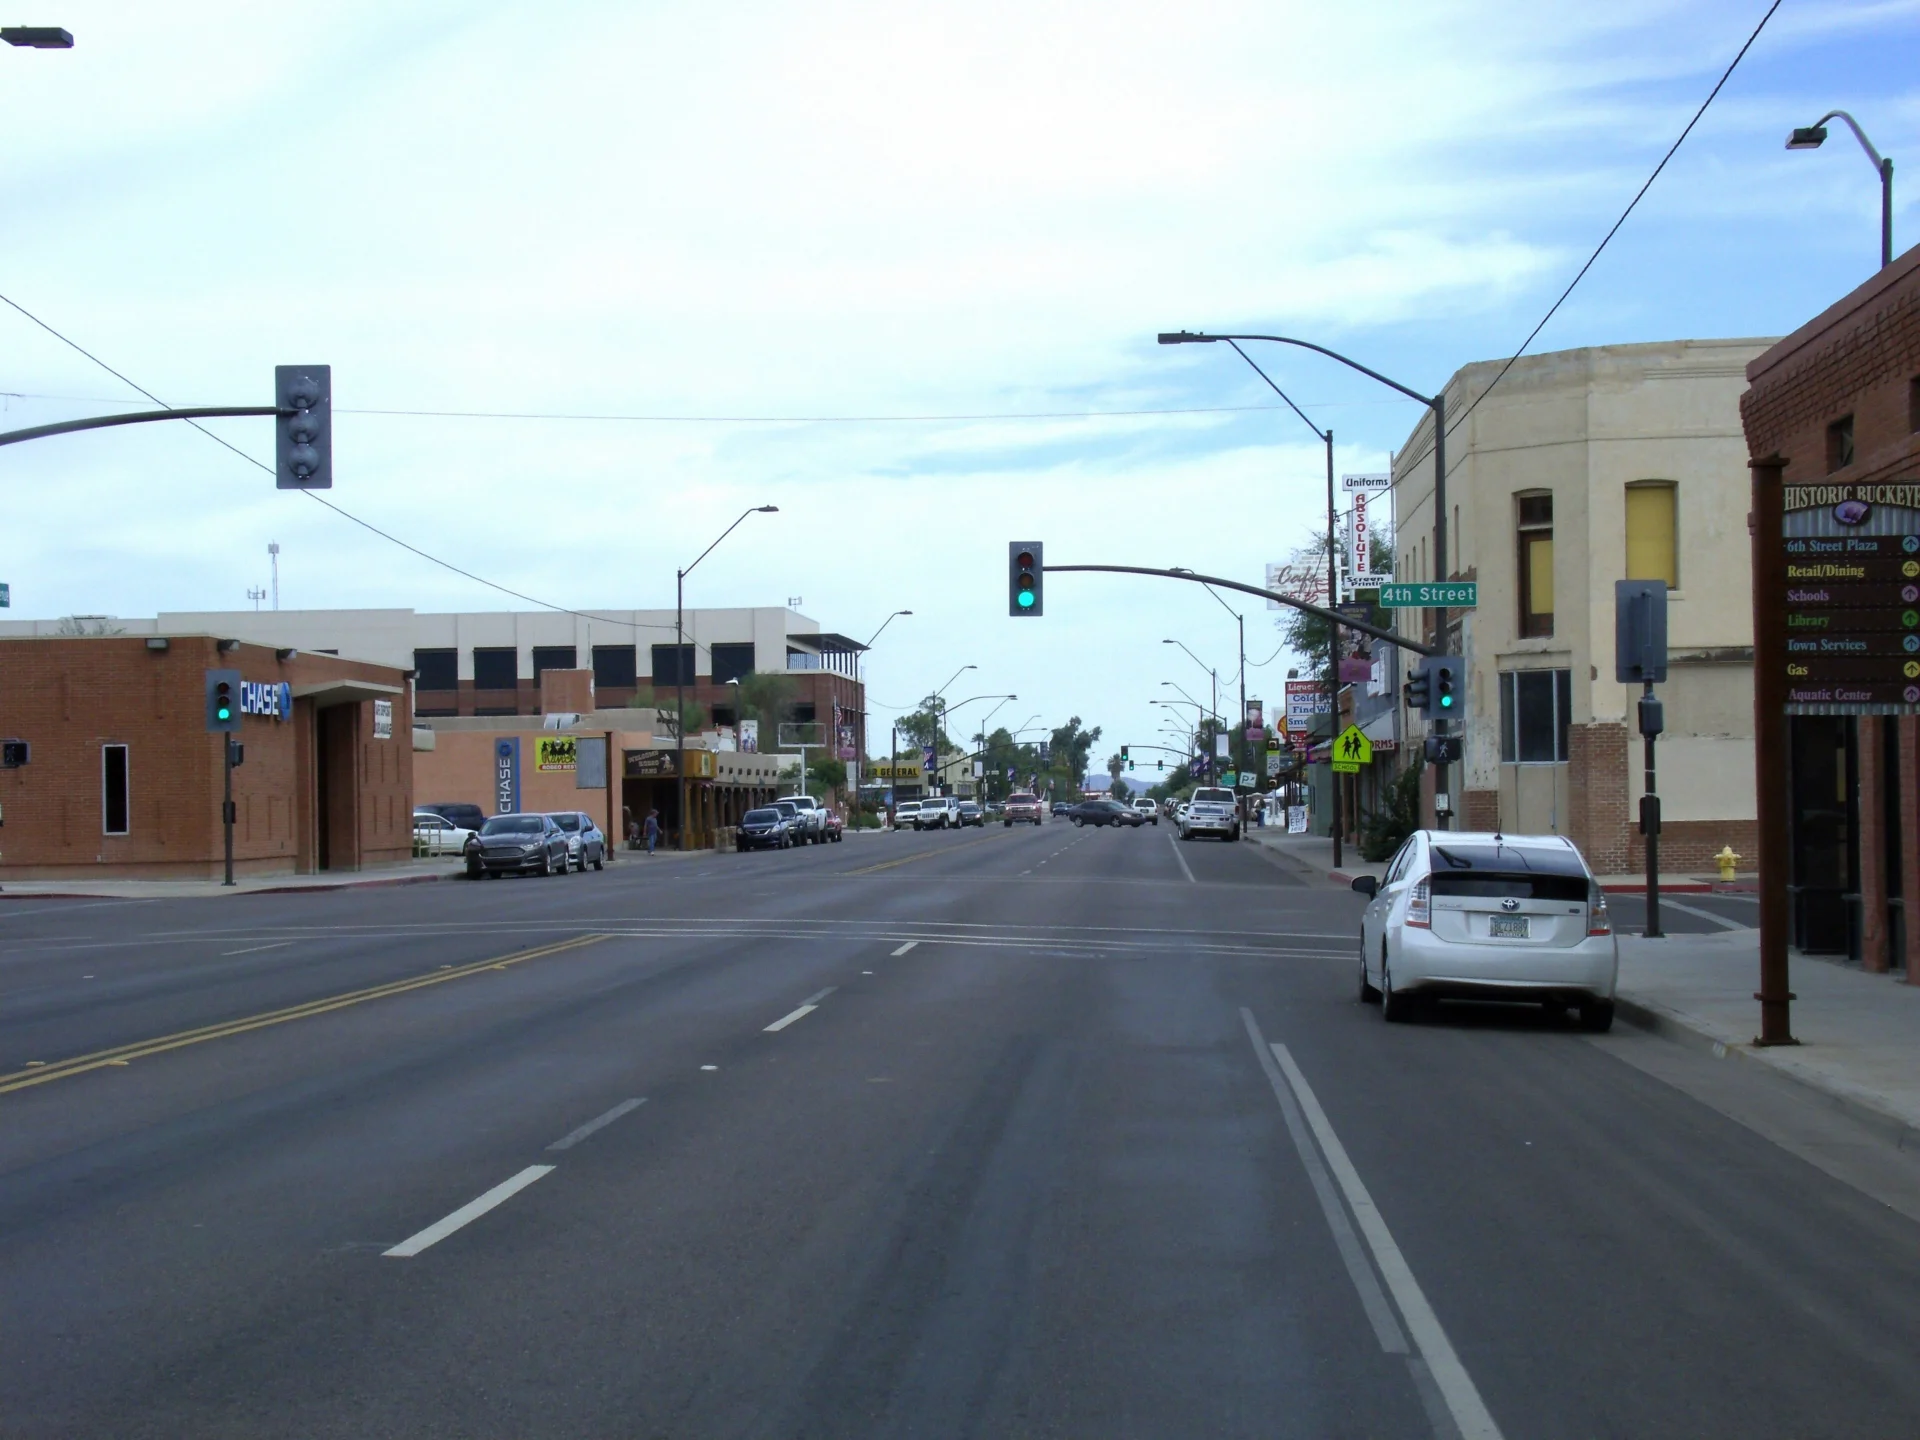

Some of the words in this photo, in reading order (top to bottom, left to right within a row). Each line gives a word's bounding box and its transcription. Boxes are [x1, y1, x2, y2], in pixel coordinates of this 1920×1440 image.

[1346, 478, 1388, 487] Uniforms
[1784, 486, 1852, 511] HISTORIC
[1355, 493, 1366, 572] ABSOLUTE
[1787, 541, 1805, 552] 6th
[1810, 540, 1842, 552] Street
[1848, 540, 1878, 551] Plaza
[1787, 565, 1865, 578] Retail/Dining
[1383, 588, 1411, 601] 4th
[1420, 588, 1474, 601] Street
[1787, 590, 1829, 602] Schools
[1788, 614, 1829, 627] Library
[1787, 639, 1817, 651] Town
[1821, 638, 1867, 651] Services
[1787, 663, 1809, 675] Gas
[240, 681, 279, 715] CHASE
[1789, 688, 1831, 702] Aquatic
[1835, 688, 1872, 700] Center
[880, 767, 918, 776] GEERAL
[500, 758, 512, 812] CHASE
